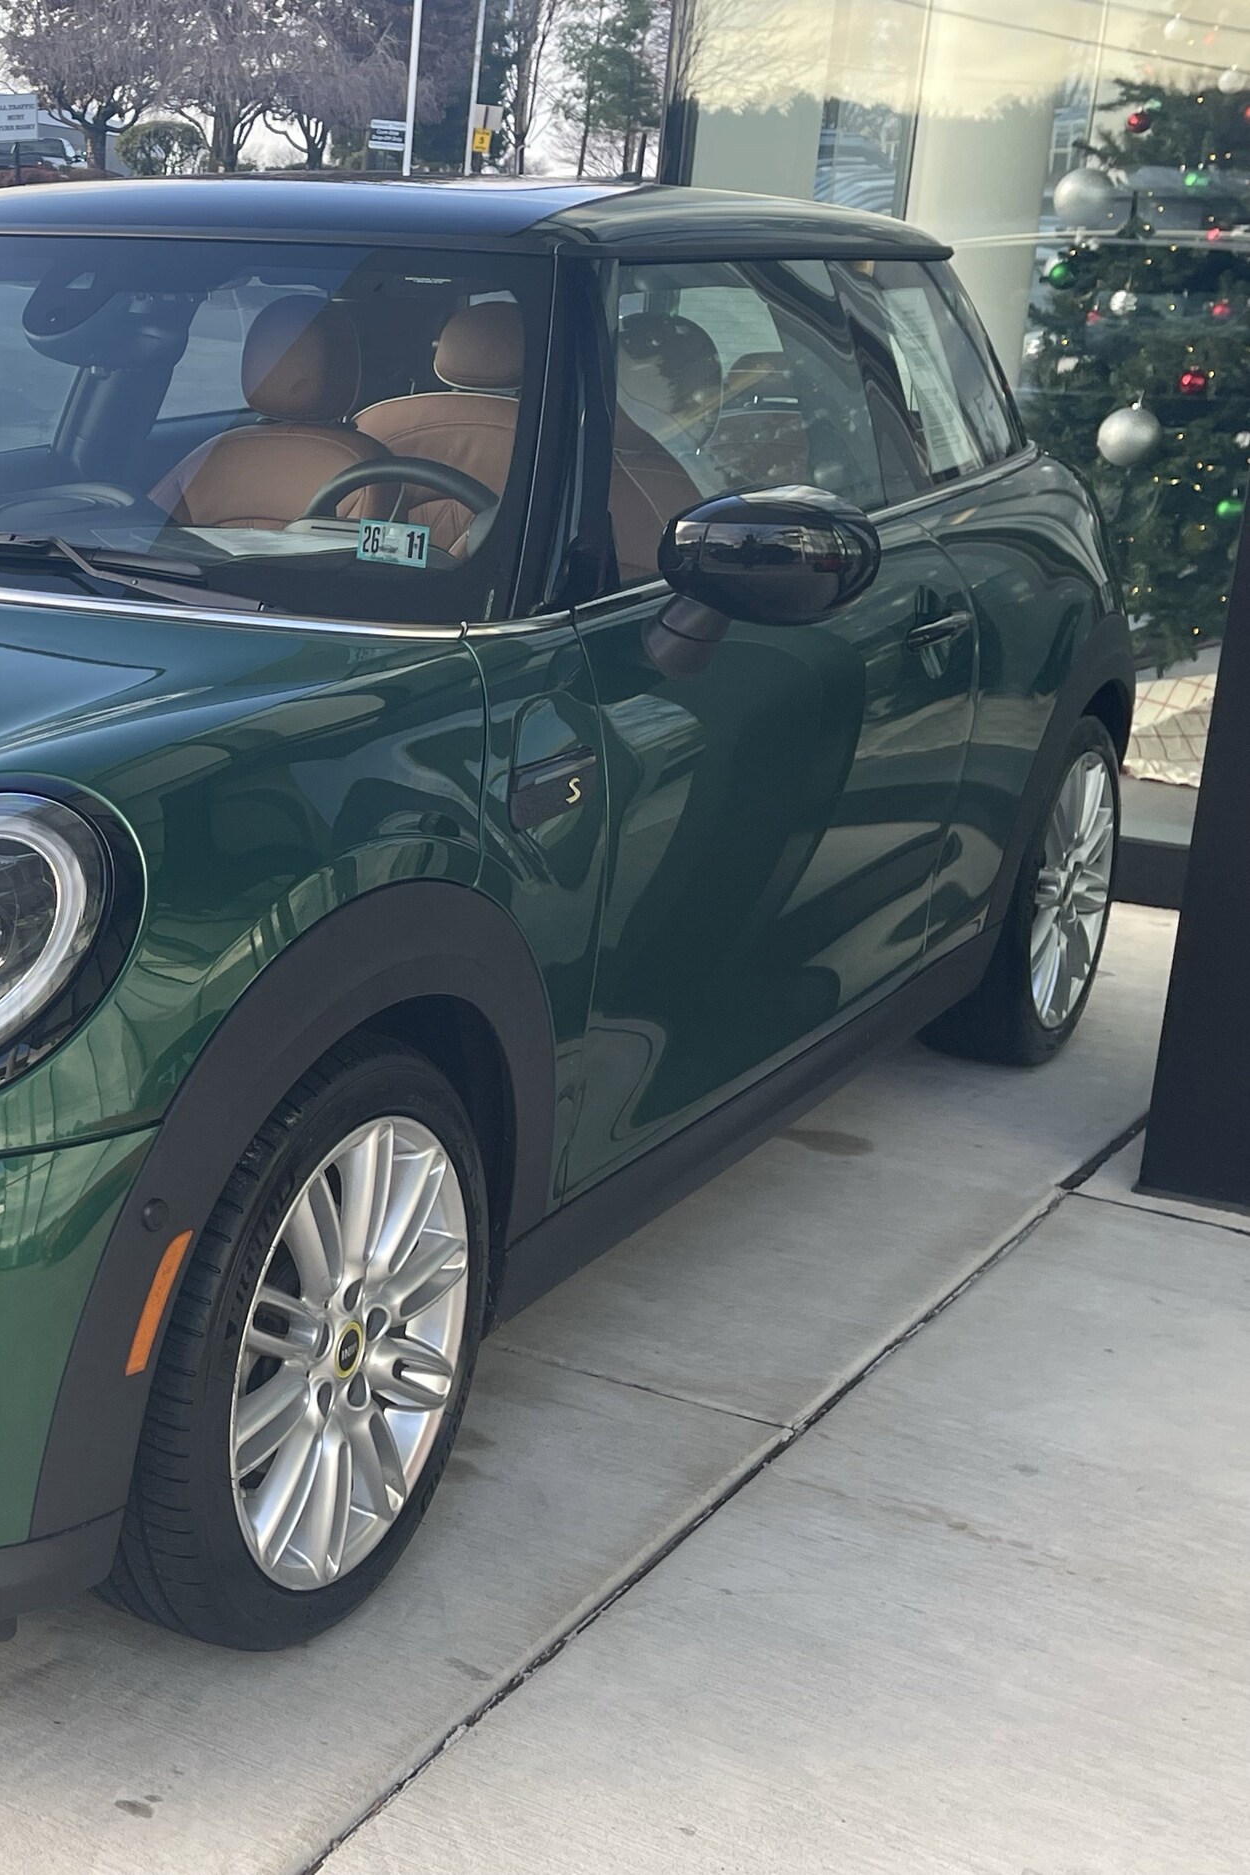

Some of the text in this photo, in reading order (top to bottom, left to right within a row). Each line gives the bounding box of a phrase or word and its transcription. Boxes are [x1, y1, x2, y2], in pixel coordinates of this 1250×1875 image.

[362, 525, 426, 560] 26 11
[565, 777, 582, 804] S
